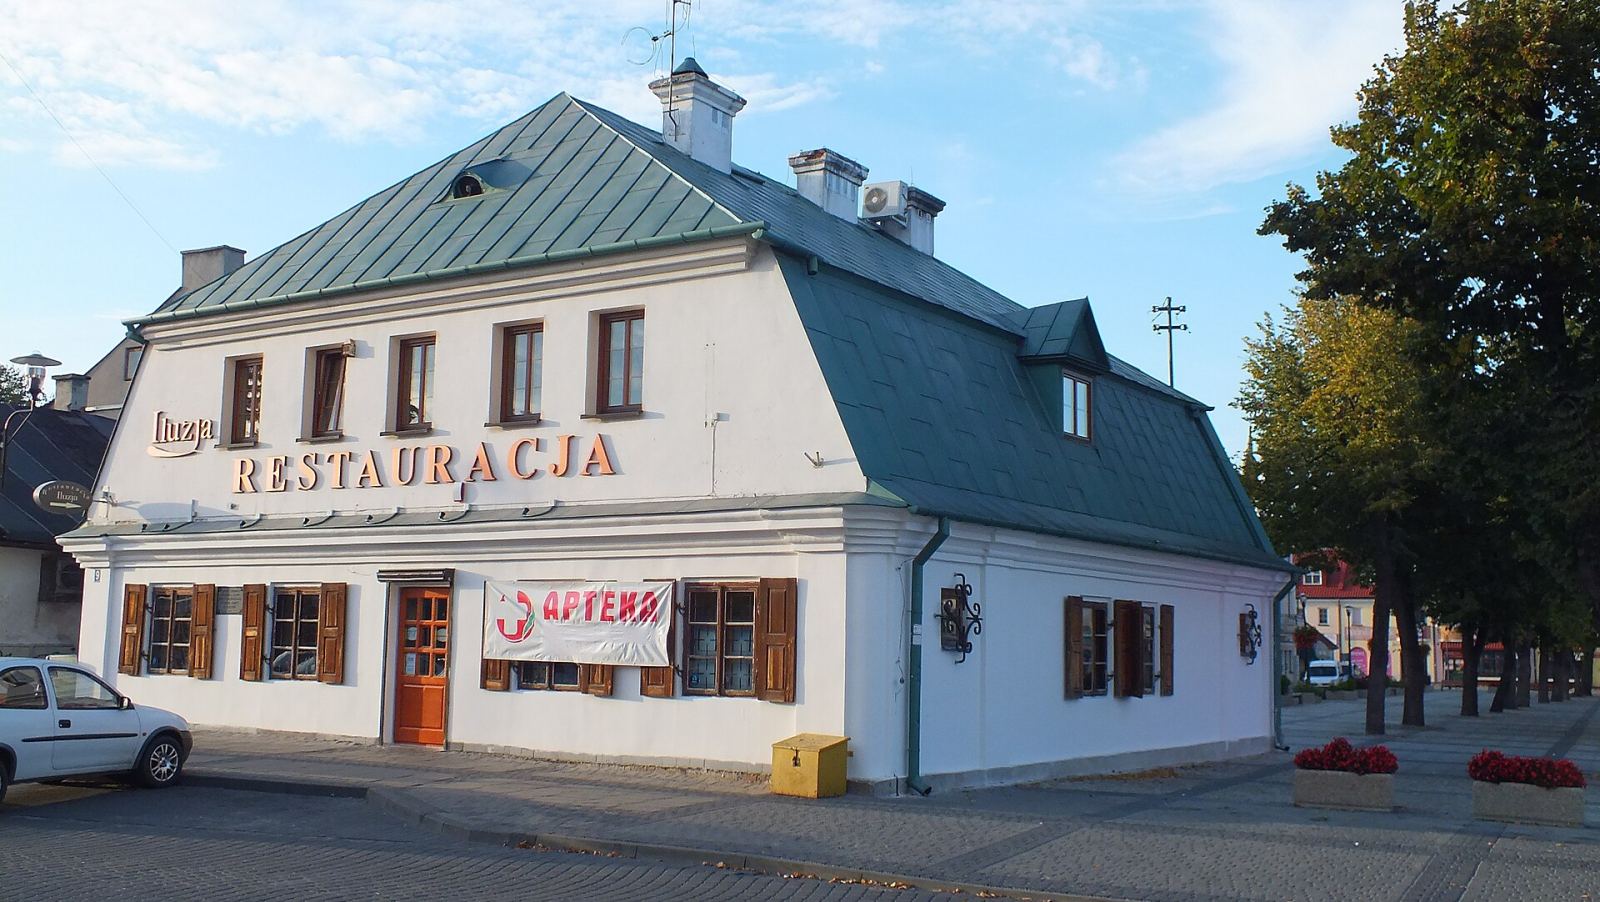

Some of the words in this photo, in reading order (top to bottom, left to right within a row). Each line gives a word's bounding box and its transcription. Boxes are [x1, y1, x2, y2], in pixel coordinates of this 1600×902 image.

[152, 410, 214, 452] Iluzja
[231, 432, 616, 494] RESTAURACJA
[543, 590, 659, 622] APTEKA
